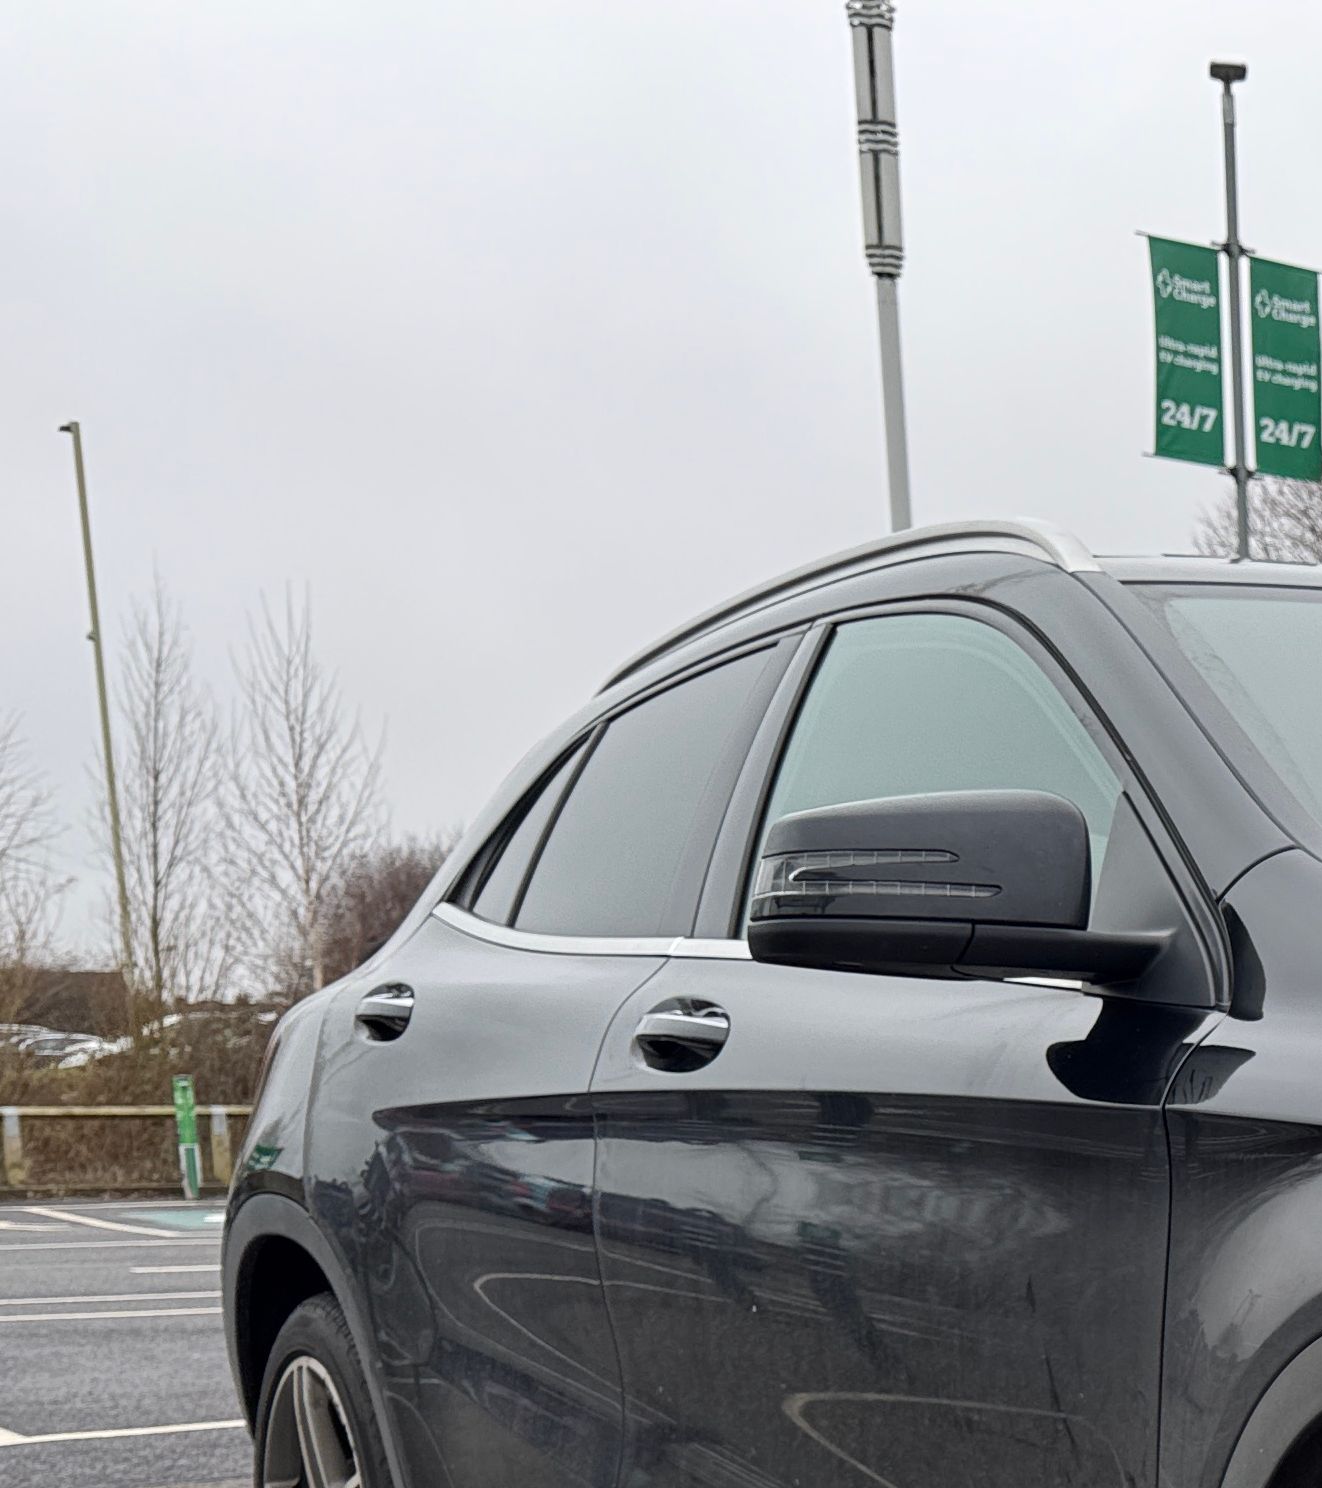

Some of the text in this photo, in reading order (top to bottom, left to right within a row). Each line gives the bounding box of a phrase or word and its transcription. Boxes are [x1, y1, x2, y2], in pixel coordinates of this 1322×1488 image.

[1173, 273, 1211, 294] Smart
[1172, 286, 1217, 309] Charge
[1272, 294, 1310, 314] Smart
[1272, 308, 1316, 328] Charge
[1158, 350, 1219, 376] EV charging
[1256, 369, 1319, 393] EV charging
[1160, 399, 1218, 433] 24/7
[1259, 417, 1316, 449] 24/7
